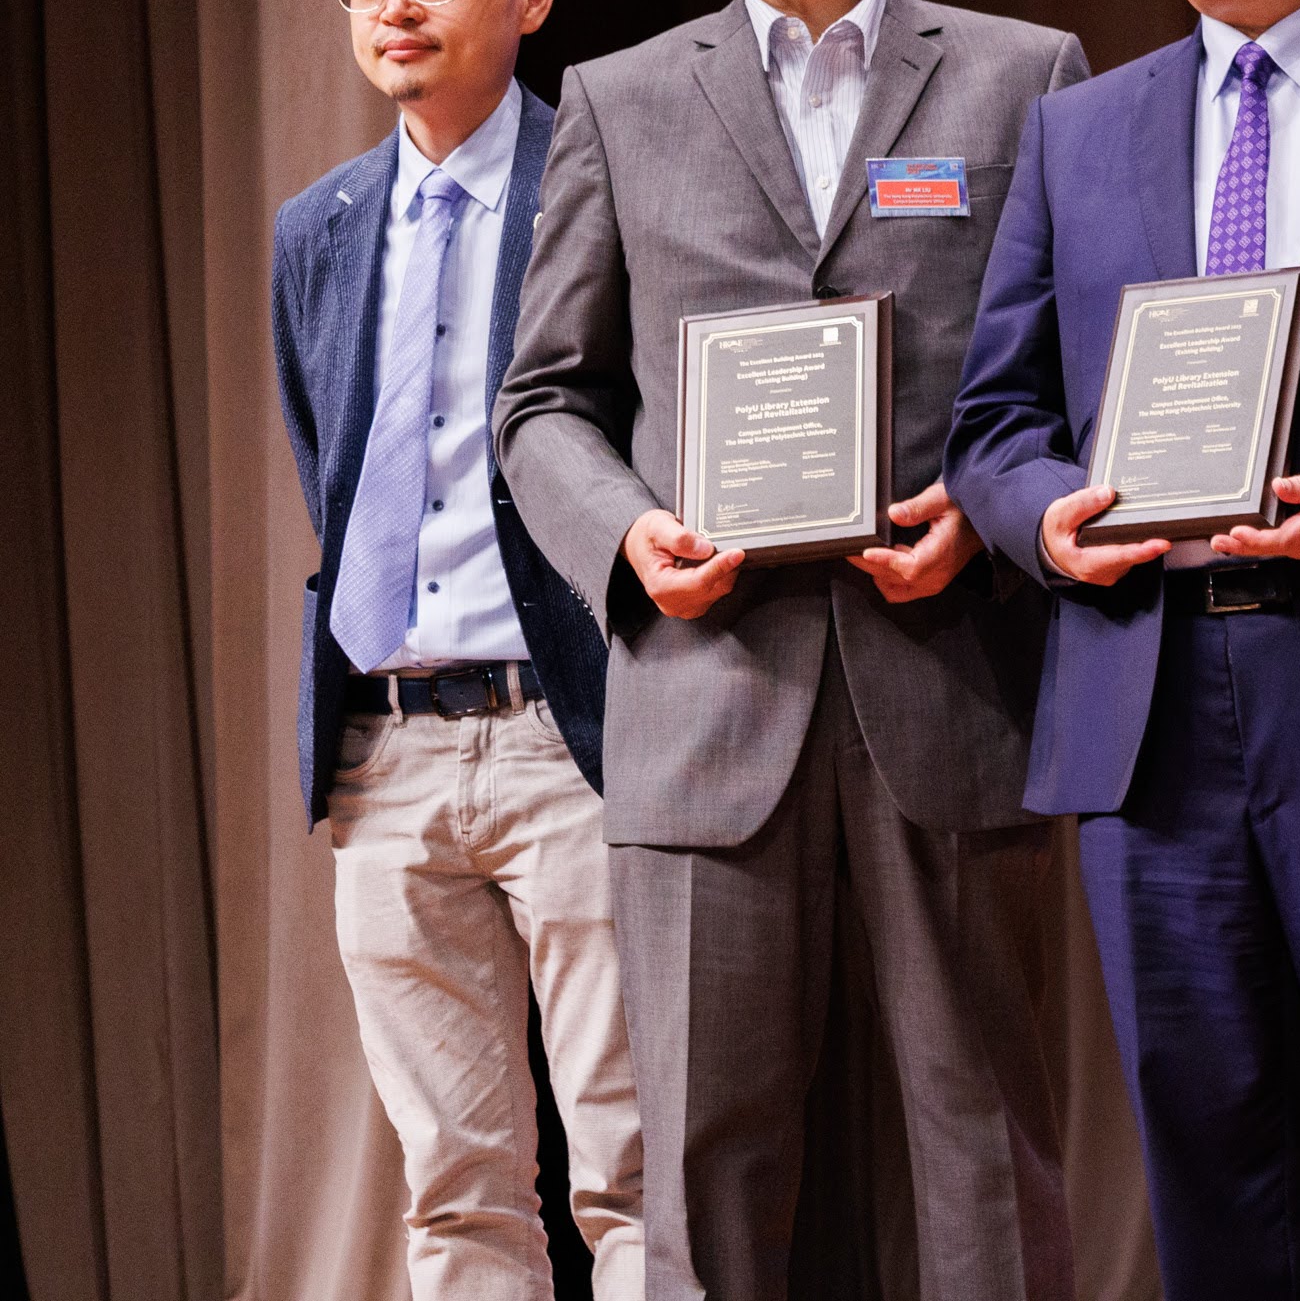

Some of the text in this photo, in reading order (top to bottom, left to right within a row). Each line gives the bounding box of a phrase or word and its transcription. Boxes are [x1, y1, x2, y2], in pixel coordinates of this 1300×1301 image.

[737, 363, 825, 380] Excellent Leadership Award
[755, 373, 808, 386] (Existing Building)
[735, 397, 830, 414] PolyU Library Extension
[747, 406, 819, 421] and Revitalization
[763, 424, 802, 434] Development
[771, 431, 806, 441] Polytechnic
[807, 427, 837, 436] University
